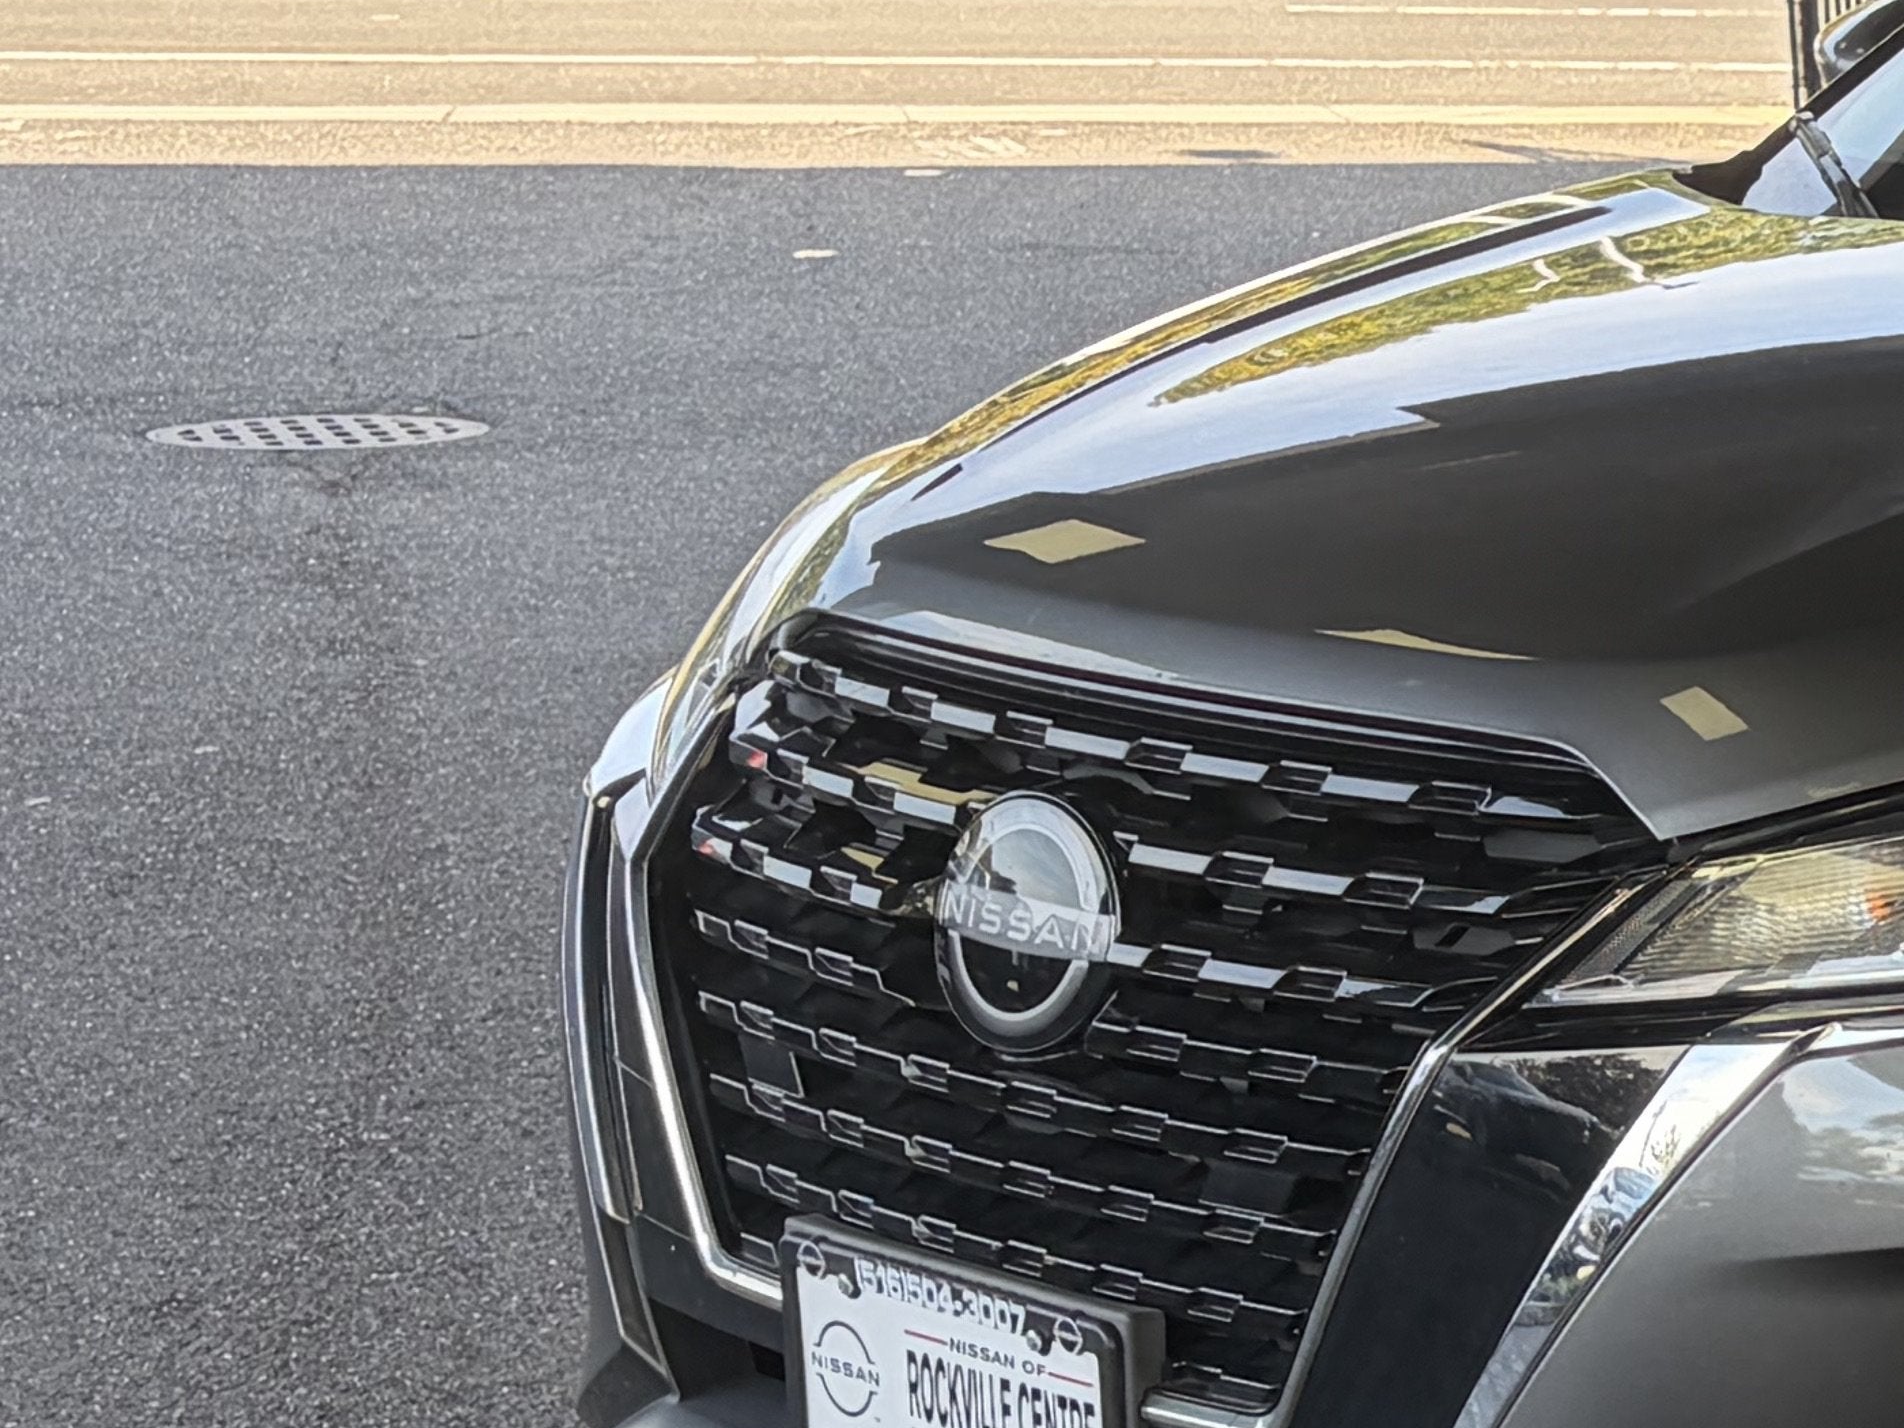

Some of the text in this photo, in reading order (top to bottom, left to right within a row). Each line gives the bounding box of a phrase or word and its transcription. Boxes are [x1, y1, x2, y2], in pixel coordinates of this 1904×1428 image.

[946, 888, 1093, 953] NISSAN
[811, 1352, 880, 1387] NISSAN
[949, 1337, 1046, 1375] NISSAN OF
